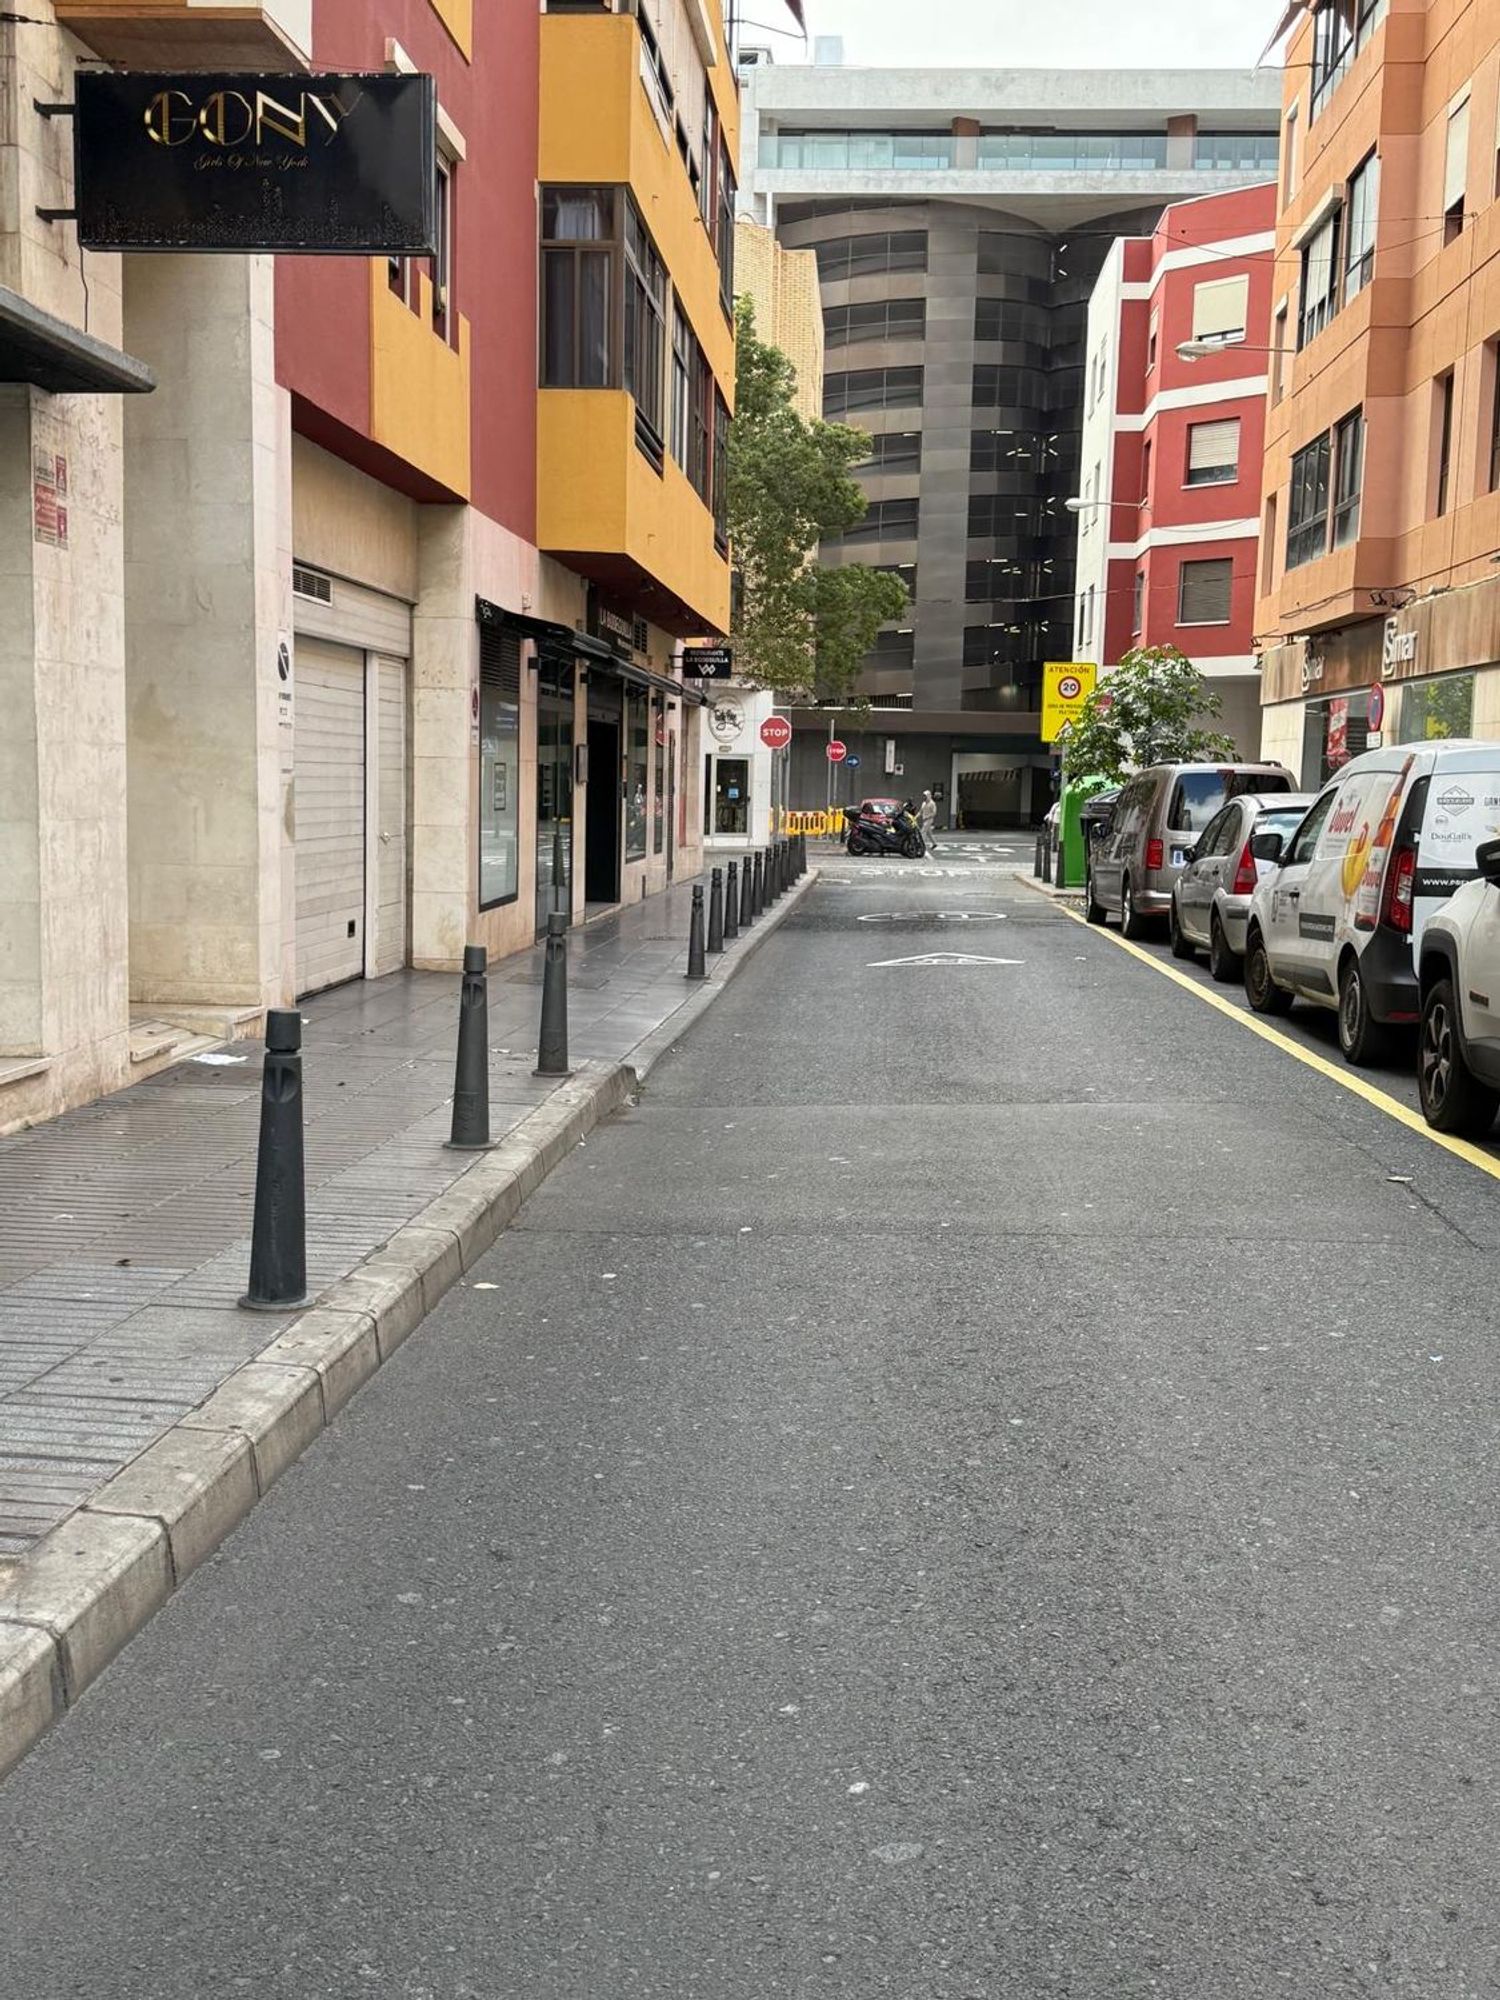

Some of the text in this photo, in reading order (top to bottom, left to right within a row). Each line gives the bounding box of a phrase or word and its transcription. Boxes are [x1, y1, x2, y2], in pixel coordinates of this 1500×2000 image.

[144, 90, 364, 147] GONY
[193, 155, 310, 171] Girls Of New York
[1048, 666, 1090, 674] ATENCIÓN
[1063, 682, 1077, 692] 20
[763, 728, 788, 737] STOP
[860, 868, 972, 878] STOP
